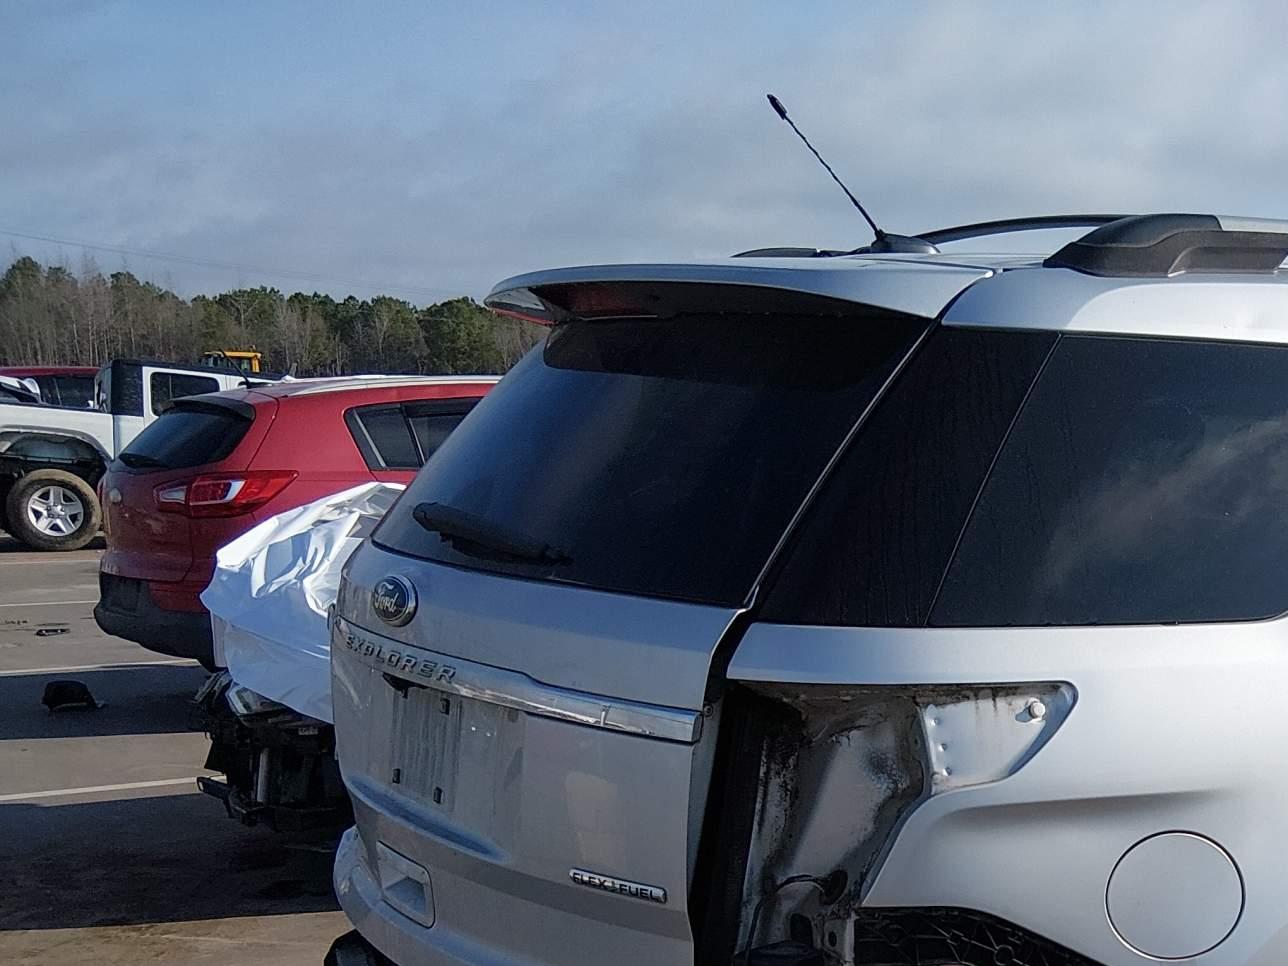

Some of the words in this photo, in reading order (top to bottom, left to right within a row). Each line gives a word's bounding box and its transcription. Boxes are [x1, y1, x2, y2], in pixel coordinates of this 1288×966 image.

[374, 576, 400, 614] Ford
[346, 635, 457, 684] EXPLORER
[572, 871, 609, 890] FLEX
[619, 883, 662, 901] FUEL
